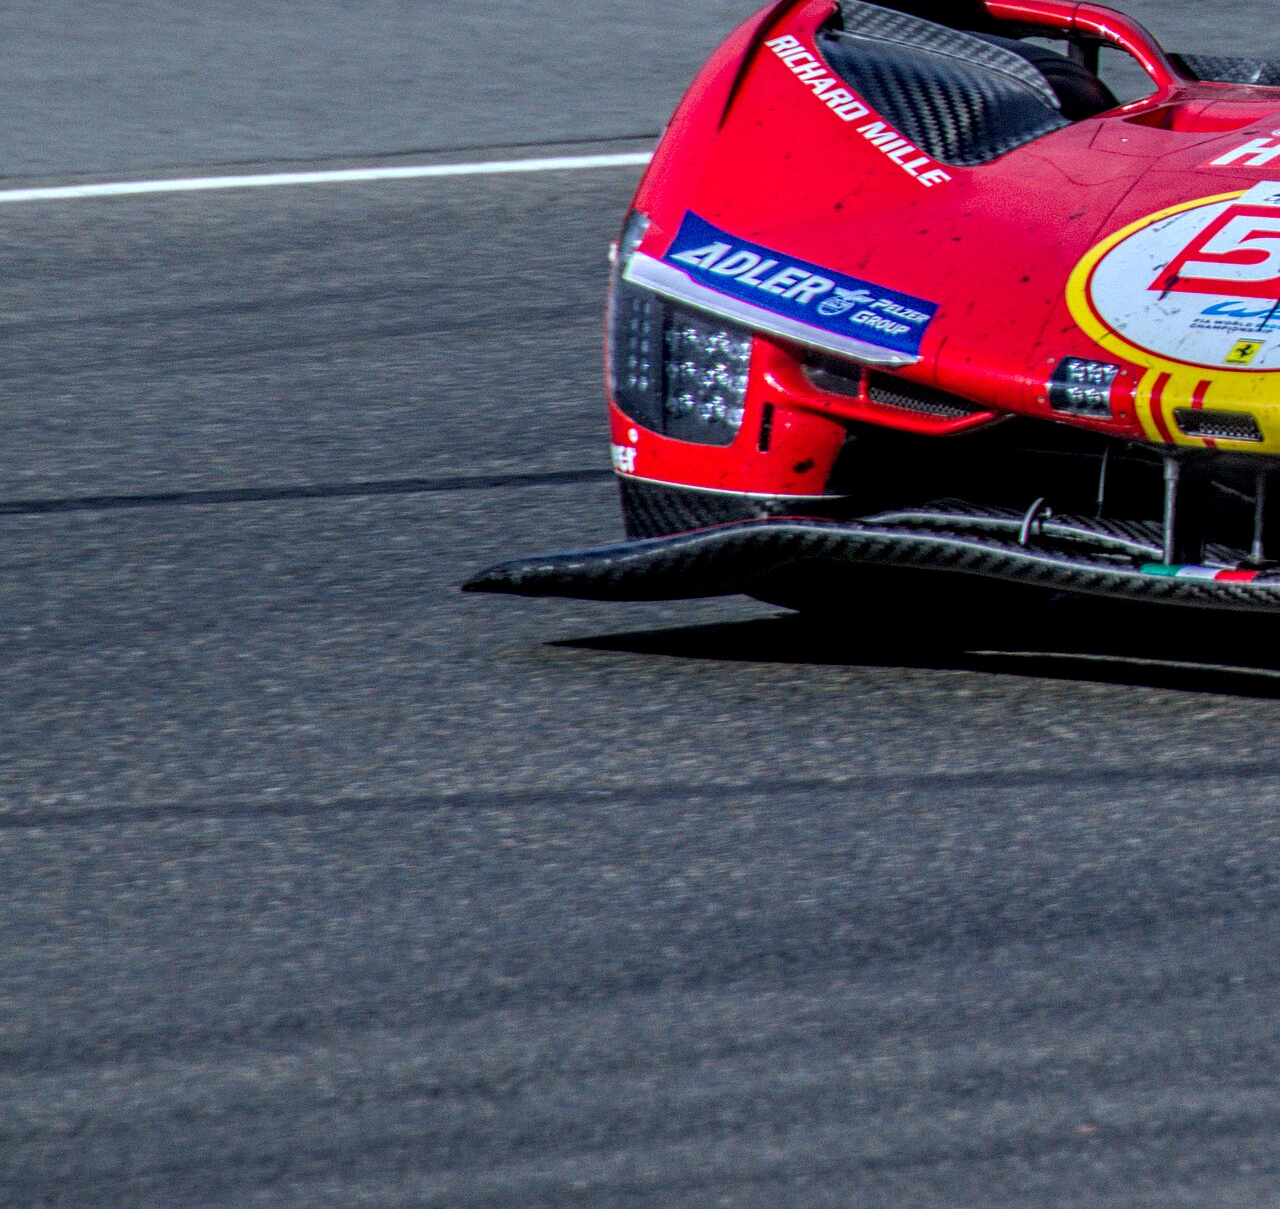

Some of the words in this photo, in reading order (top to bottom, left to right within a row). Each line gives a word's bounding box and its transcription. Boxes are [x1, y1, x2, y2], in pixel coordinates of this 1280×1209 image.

[764, 34, 870, 121] RICHARD
[856, 120, 953, 188] MILLE
[669, 240, 836, 307] ADLER
[849, 310, 911, 335] GROUP
[867, 298, 931, 323] PELZER
